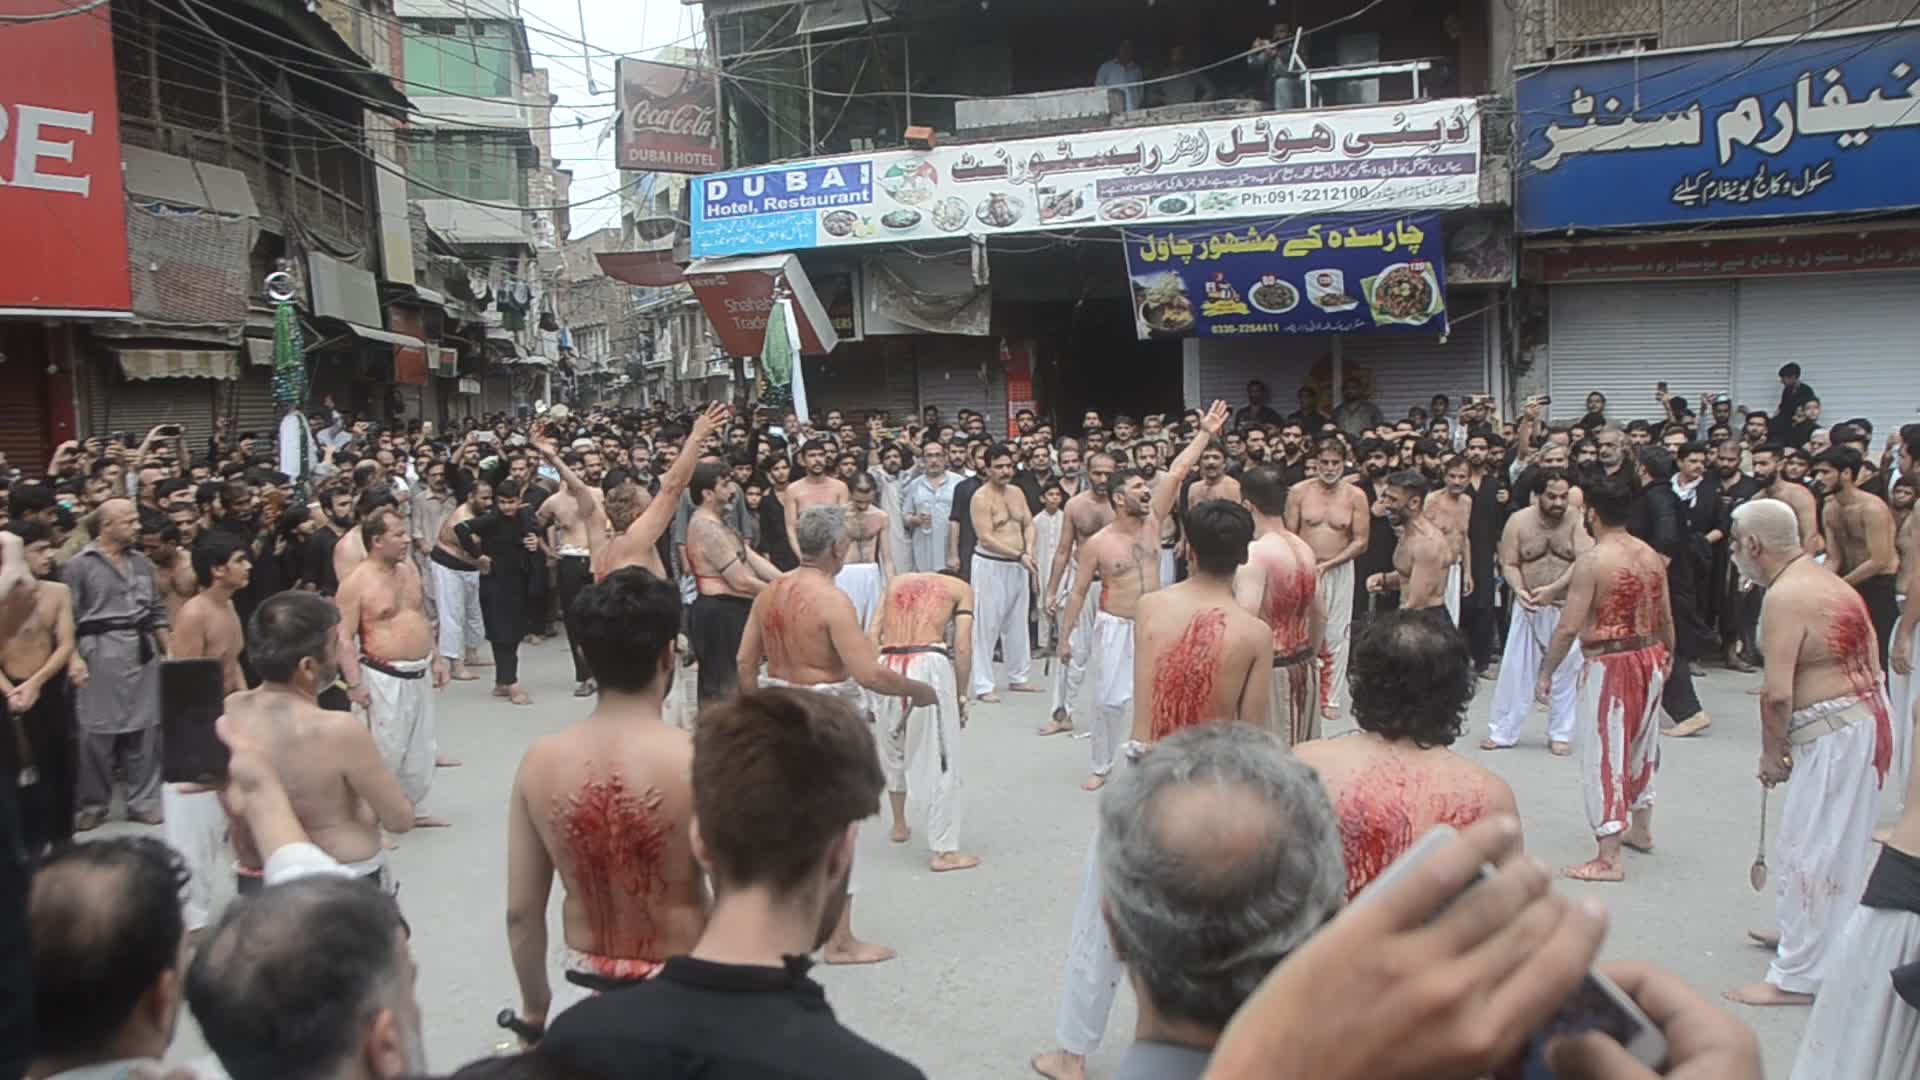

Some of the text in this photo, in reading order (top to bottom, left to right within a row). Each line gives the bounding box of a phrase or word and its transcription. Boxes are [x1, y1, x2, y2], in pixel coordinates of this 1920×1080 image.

[0, 103, 95, 199] E
[629, 148, 716, 166] DUBAI HOTEL
[707, 164, 870, 200] DUBAI
[1792, 161, 1832, 197] سکول
[707, 189, 870, 217] Hotel, Restaurant
[1140, 233, 1194, 264] چاول
[1283, 225, 1322, 257] کے
